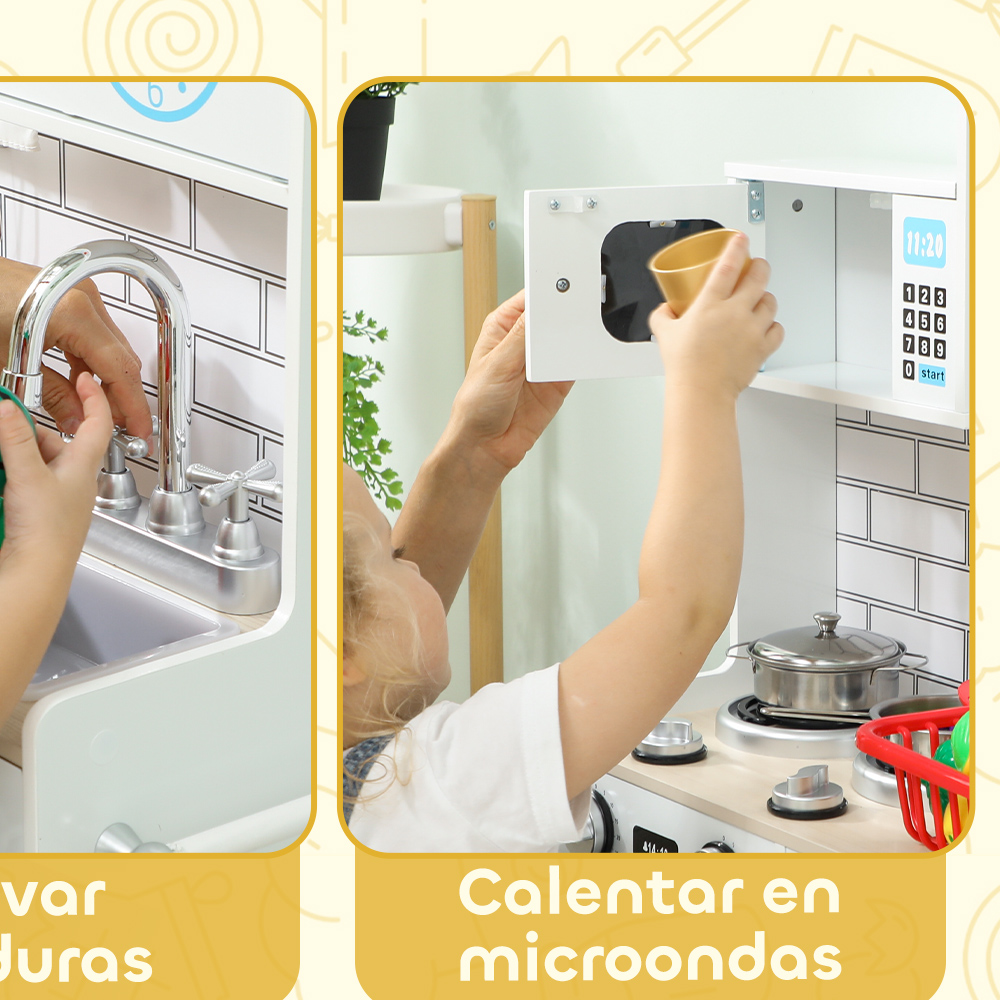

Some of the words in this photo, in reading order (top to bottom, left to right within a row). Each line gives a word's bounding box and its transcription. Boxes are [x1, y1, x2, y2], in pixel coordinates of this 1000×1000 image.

[906, 230, 944, 259] 11:20
[906, 286, 912, 301] 1
[921, 288, 928, 304] 2
[936, 290, 944, 305] 3
[905, 311, 913, 326] 4
[921, 314, 928, 329] 5
[936, 316, 944, 331] 6
[905, 337, 912, 352] 7
[921, 339, 928, 355] 8
[936, 342, 944, 357] 9
[905, 363, 912, 377] 0
[921, 368, 945, 382] start
